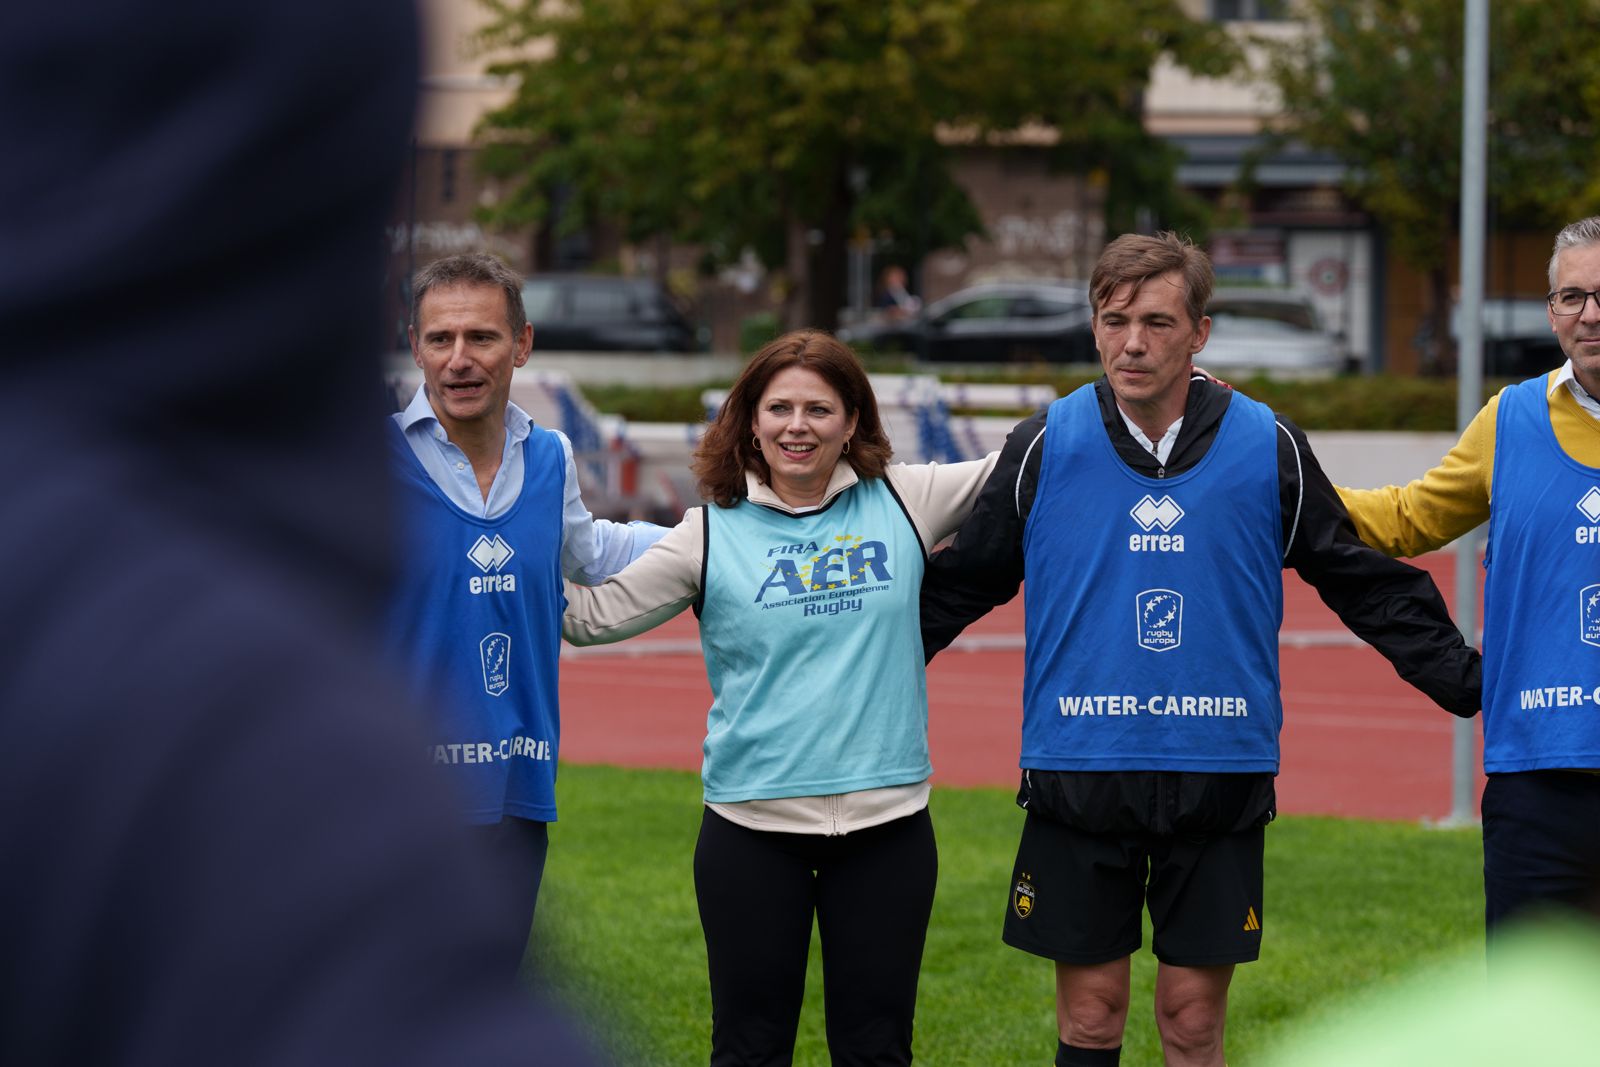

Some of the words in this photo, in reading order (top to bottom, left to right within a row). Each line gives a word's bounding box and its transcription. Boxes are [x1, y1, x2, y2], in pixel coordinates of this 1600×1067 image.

[1129, 534, 1185, 552] errea
[1575, 526, 1600, 544] er
[767, 541, 819, 557] FIRA
[754, 541, 893, 603] AER
[469, 574, 516, 594] errea
[761, 593, 826, 611] Association
[828, 584, 890, 600] Européenne
[803, 598, 863, 617] Rugby
[1146, 629, 1173, 638] rugby
[1058, 695, 1248, 717] WATER-CARRIER
